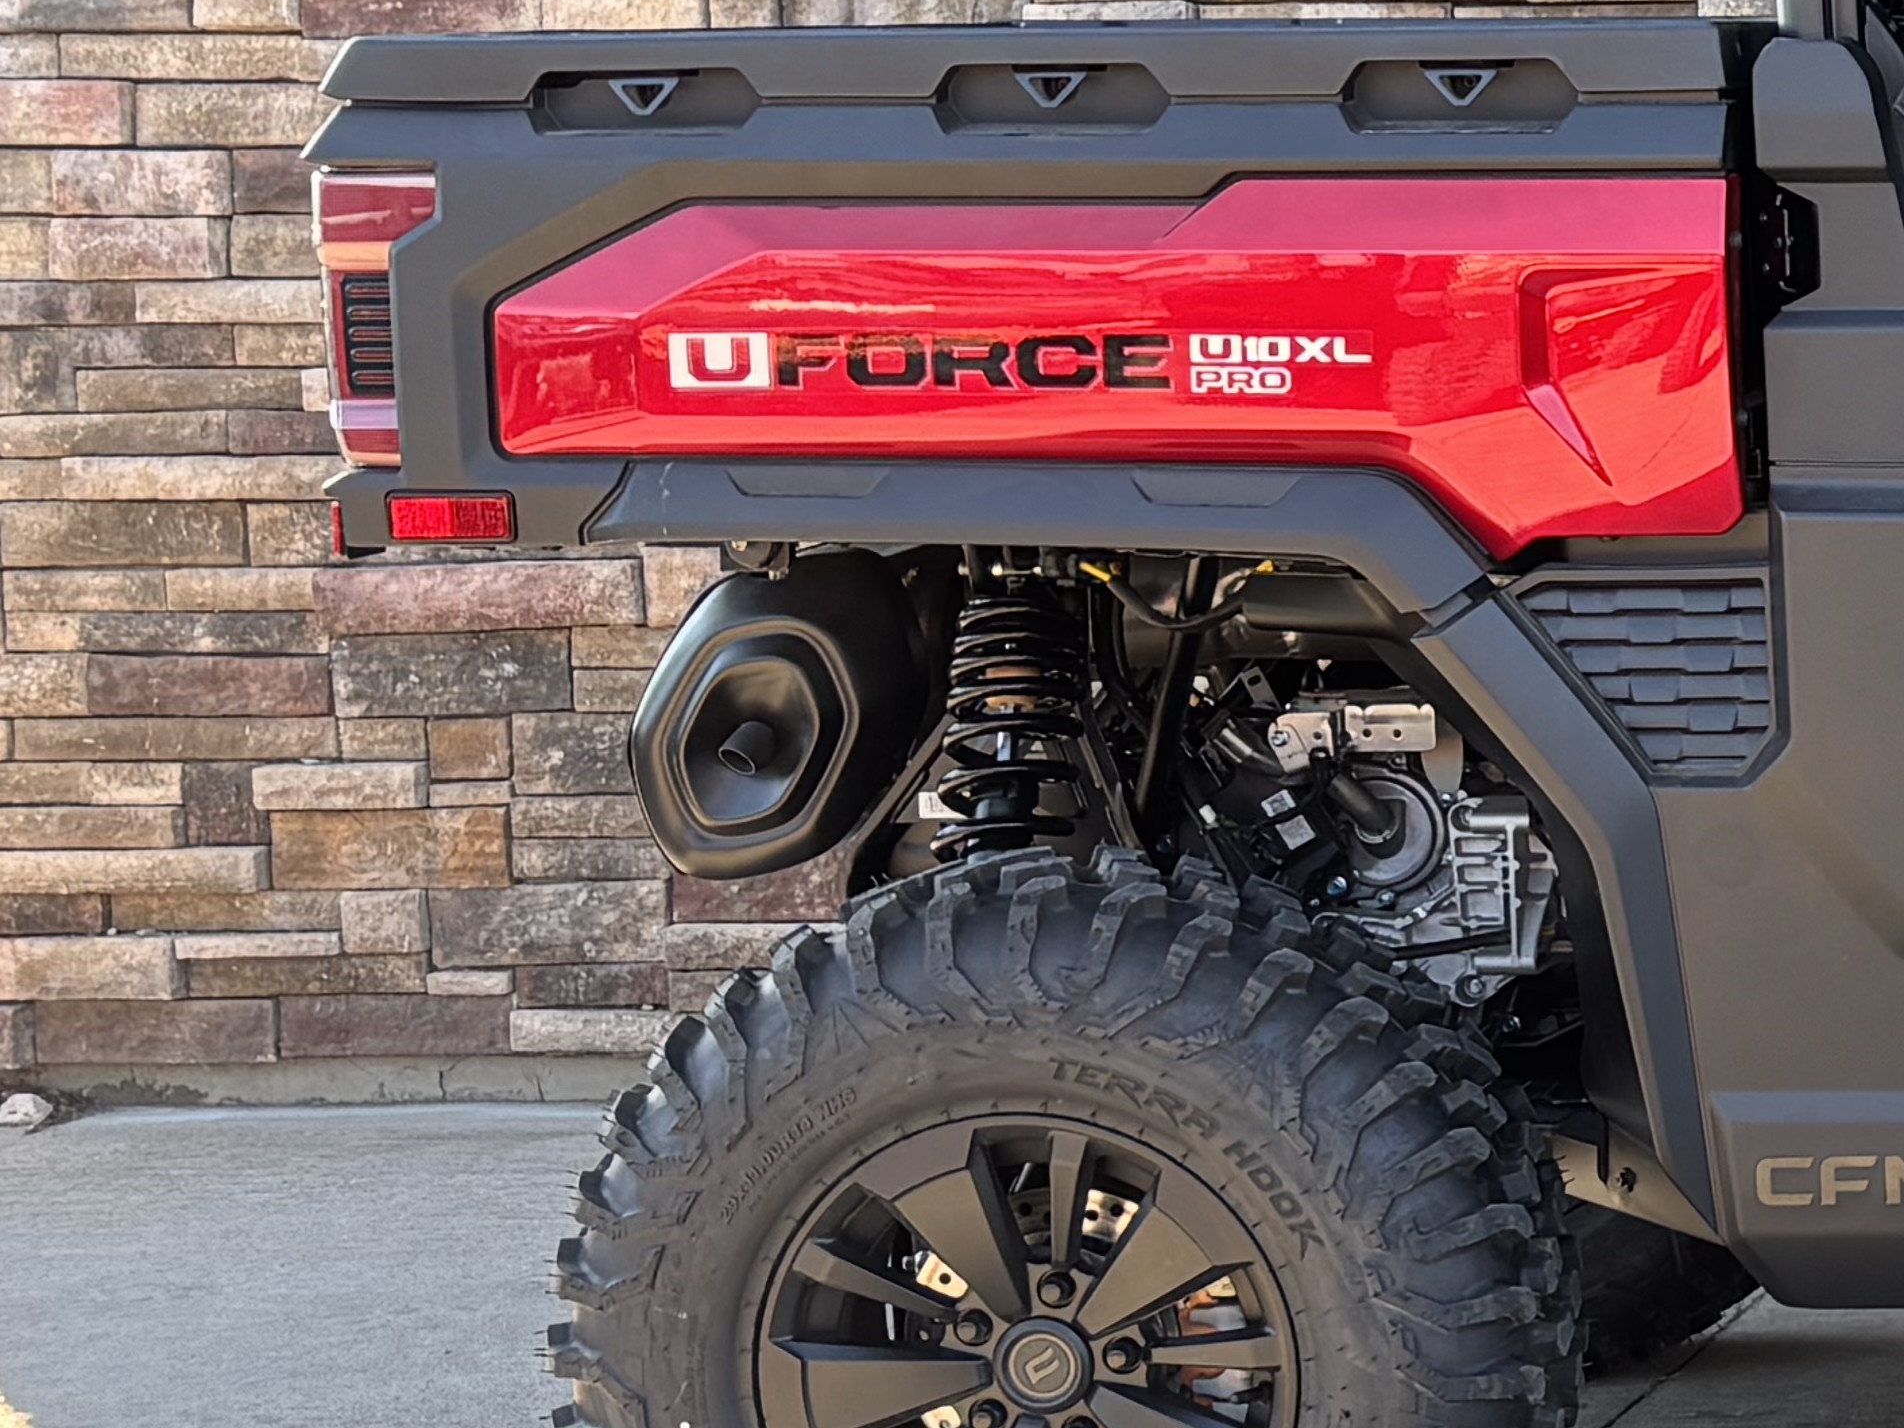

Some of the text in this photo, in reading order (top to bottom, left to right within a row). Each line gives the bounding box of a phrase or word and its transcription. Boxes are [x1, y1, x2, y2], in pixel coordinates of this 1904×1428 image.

[1190, 365, 1292, 394] PRO
[1049, 1056, 1325, 1262] TERRA HOOK
